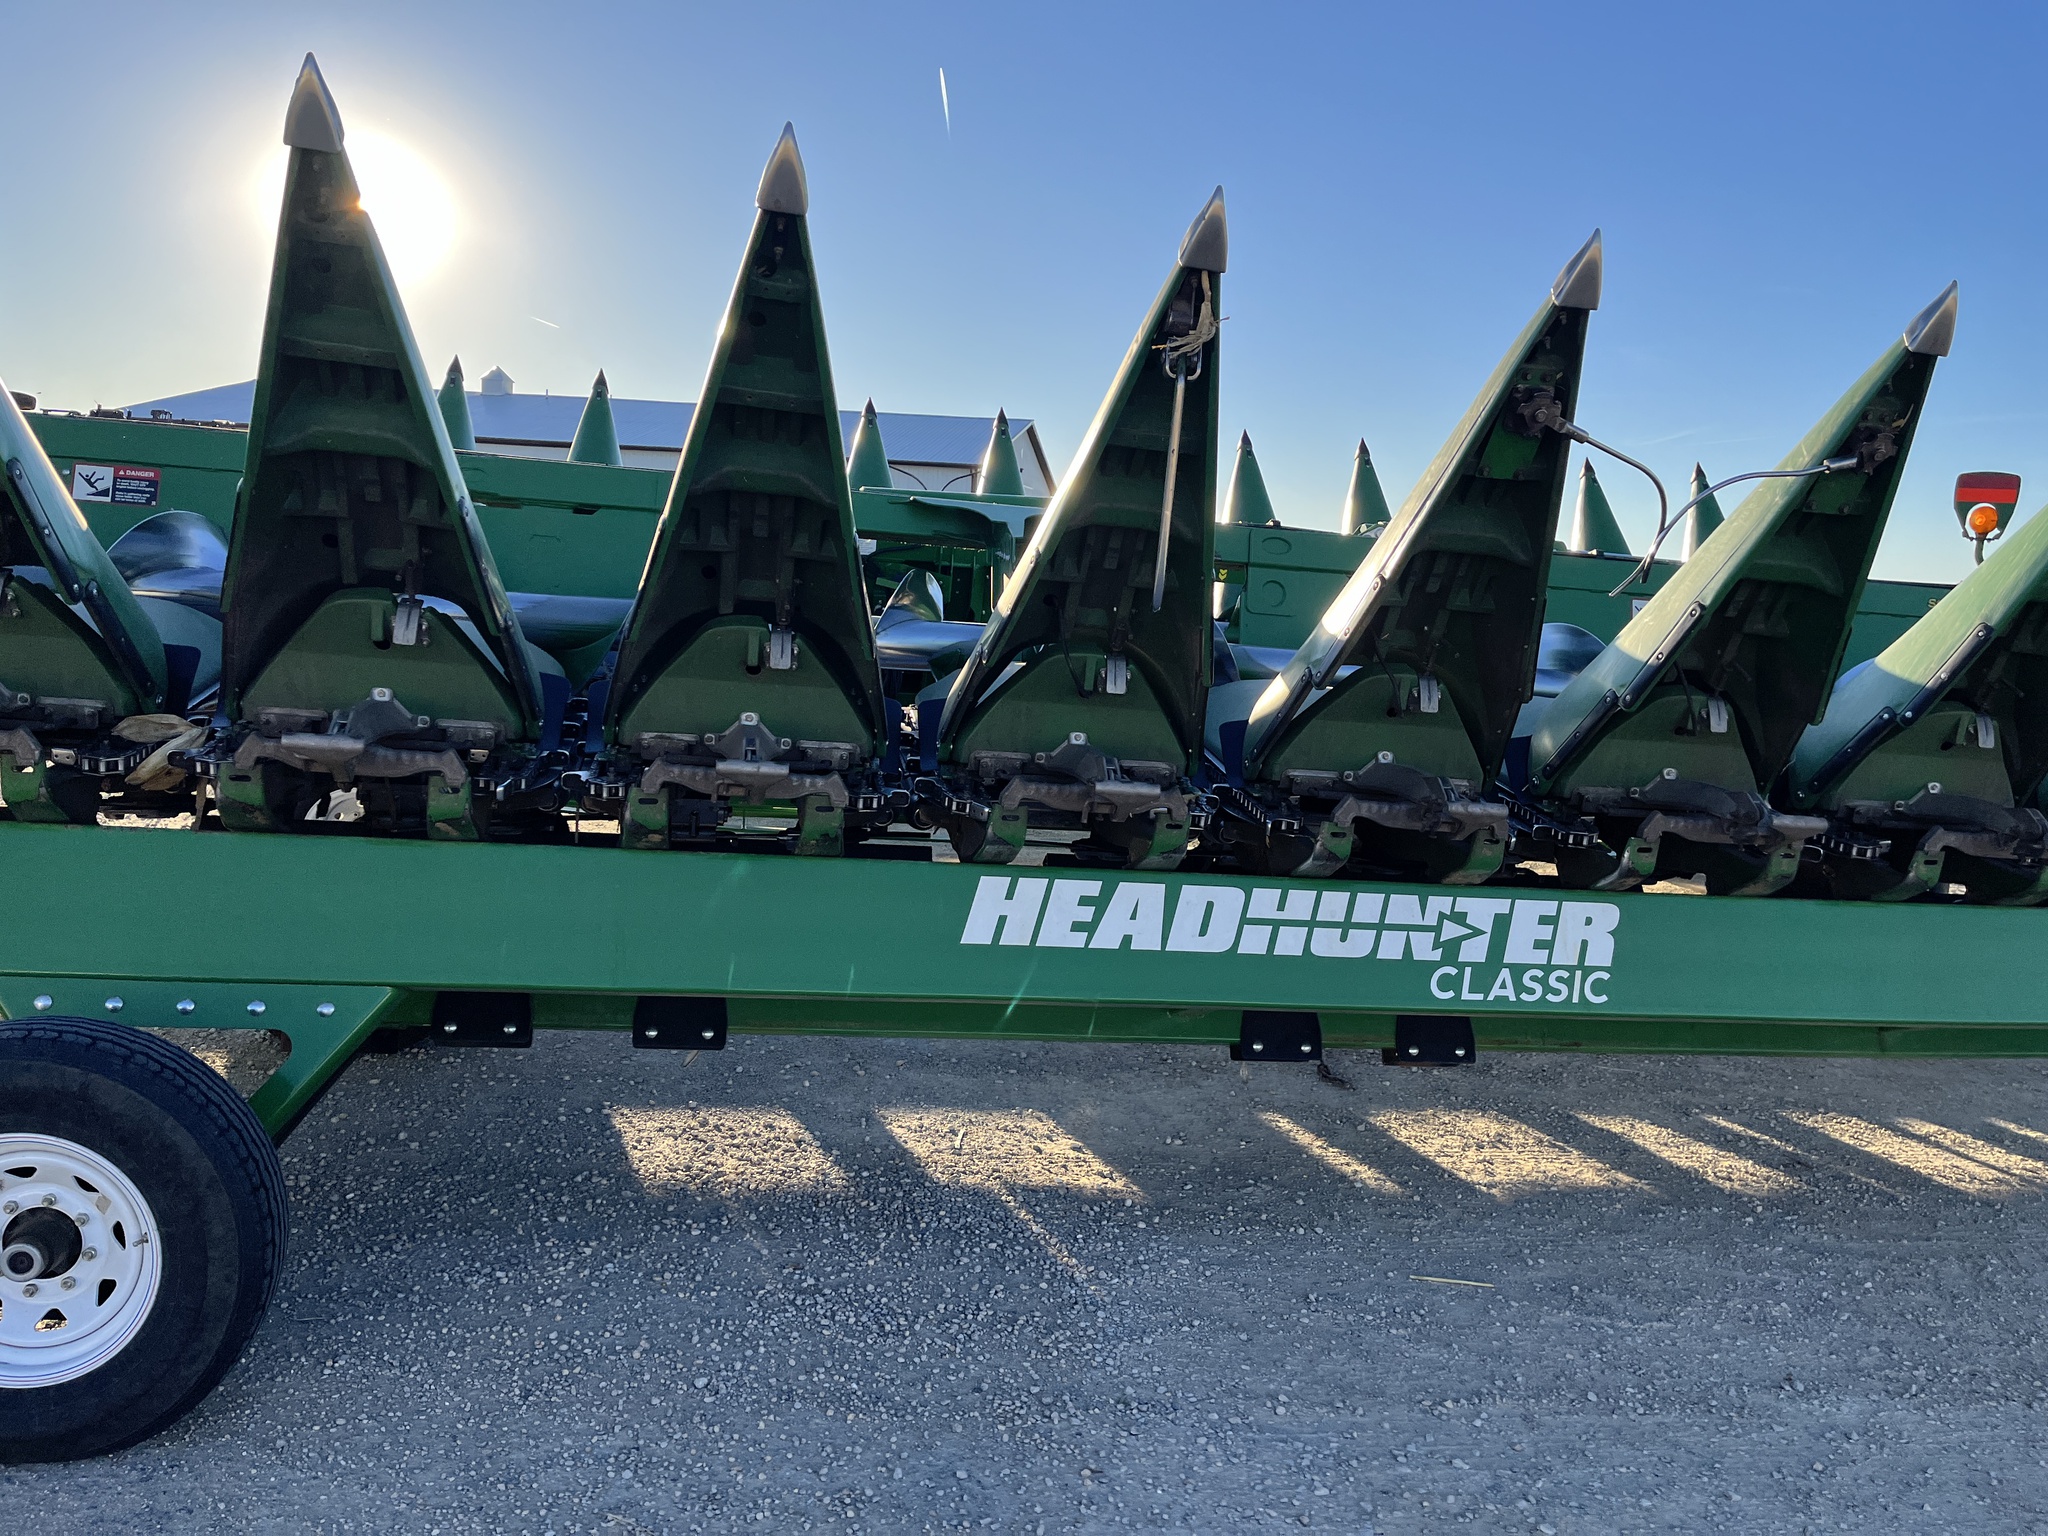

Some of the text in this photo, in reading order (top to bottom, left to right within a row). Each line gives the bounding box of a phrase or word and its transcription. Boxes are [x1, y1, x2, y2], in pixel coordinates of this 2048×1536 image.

[125, 469, 155, 478] DANGER
[960, 875, 1620, 966] HEADHUNTER
[1430, 966, 1611, 1005] CLASSIC
